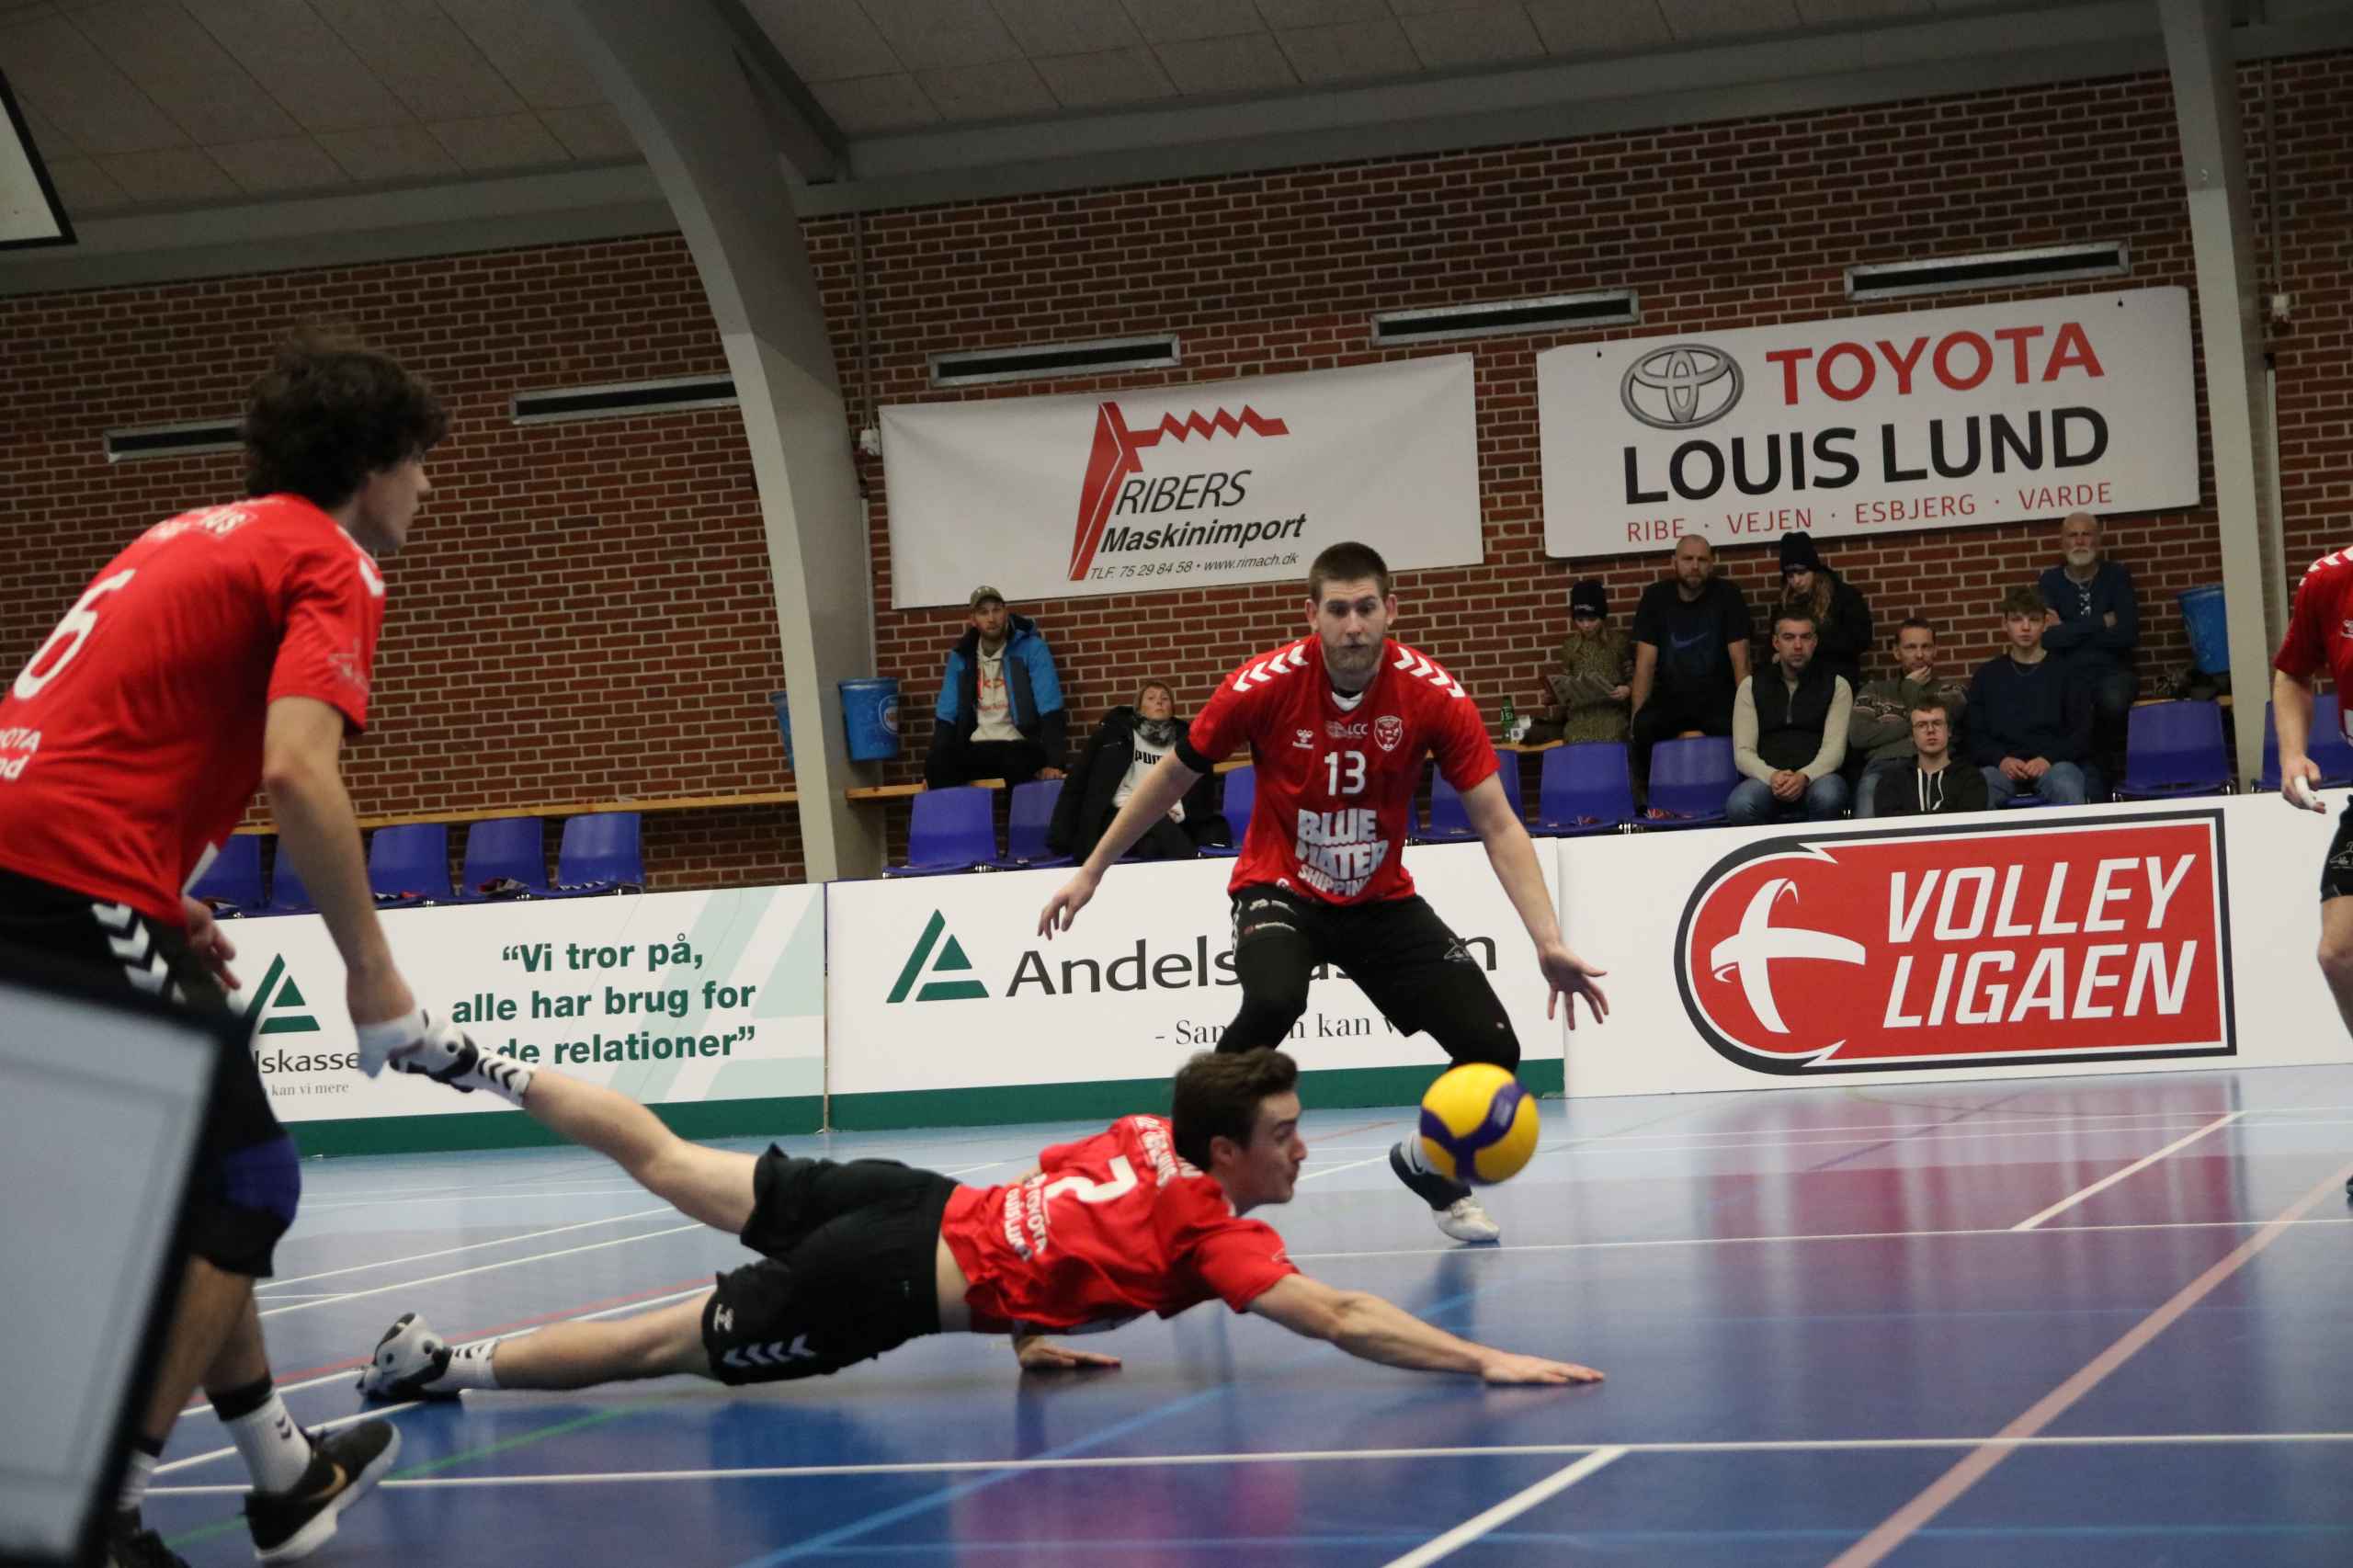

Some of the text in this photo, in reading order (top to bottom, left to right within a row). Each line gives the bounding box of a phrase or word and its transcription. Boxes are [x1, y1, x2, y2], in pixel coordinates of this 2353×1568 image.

[1766, 322, 2105, 405] TOYOTA
[1623, 406, 2109, 505] LOUIS LUND
[1116, 470, 1252, 515] RIBERS
[1627, 482, 2113, 542] RIBE VEJEN ESBJERG VARDE
[1100, 513, 1306, 553] Maskinimport
[1090, 552, 1298, 580] TLF. 75 29 84 58 www.rimach.dk
[13, 569, 136, 699] 6
[1324, 750, 1366, 796] 13
[1298, 808, 1378, 846] BLUE
[1888, 853, 2196, 944] VOLLEY
[566, 942, 635, 970] tror
[647, 933, 704, 971] på,
[451, 979, 756, 1023] alle har brug for
[1883, 939, 2199, 1028] LIGAEN
[1317, 1013, 1370, 1039] kan
[272, 1083, 349, 1096] kan vi mere
[1042, 1154, 1139, 1204] 2
